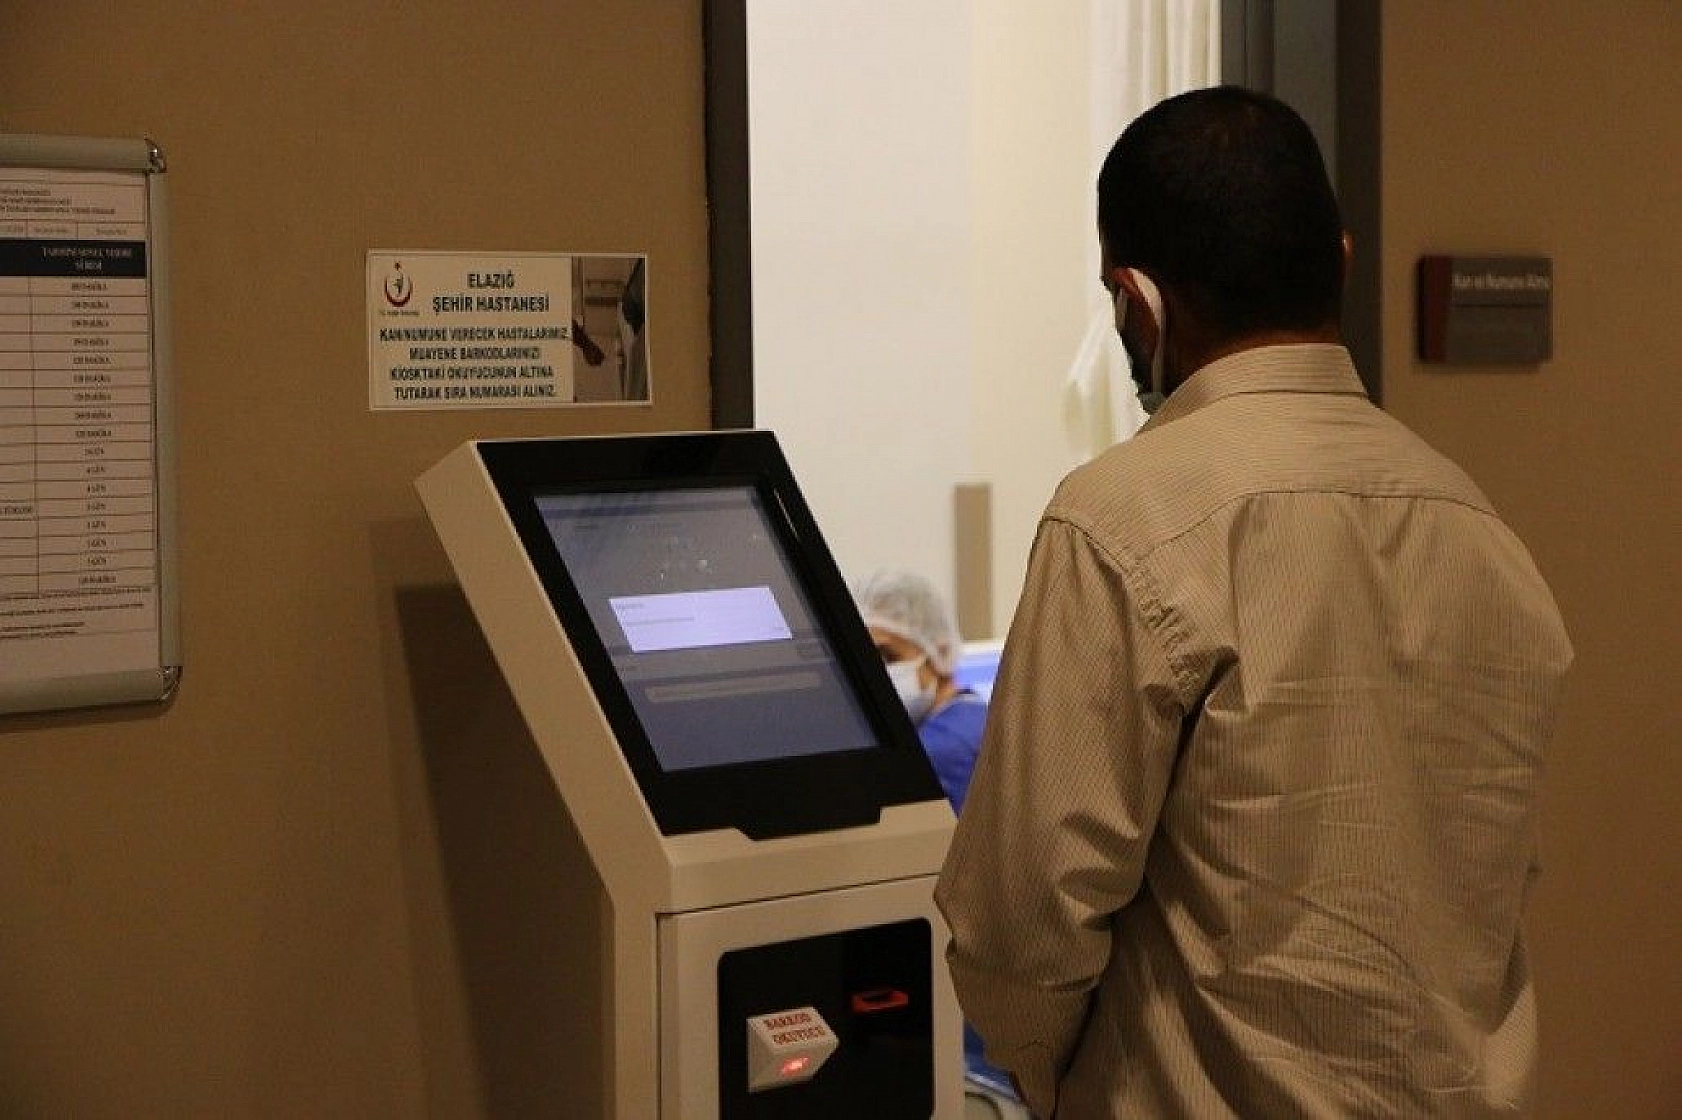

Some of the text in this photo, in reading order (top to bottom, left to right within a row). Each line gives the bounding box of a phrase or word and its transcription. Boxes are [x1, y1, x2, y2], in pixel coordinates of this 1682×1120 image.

[467, 270, 515, 288] ELAZIĞ
[432, 293, 550, 316] ŞEHİR HASTANESİ
[449, 327, 496, 341] VERECEK
[409, 347, 458, 360] MUAYENE
[447, 366, 517, 380] OKUYUCUNUN
[518, 365, 554, 379] ALTINA
[394, 386, 442, 400] TUTARAK
[444, 386, 467, 399] SIRA
[469, 385, 522, 399] NUMARASI
